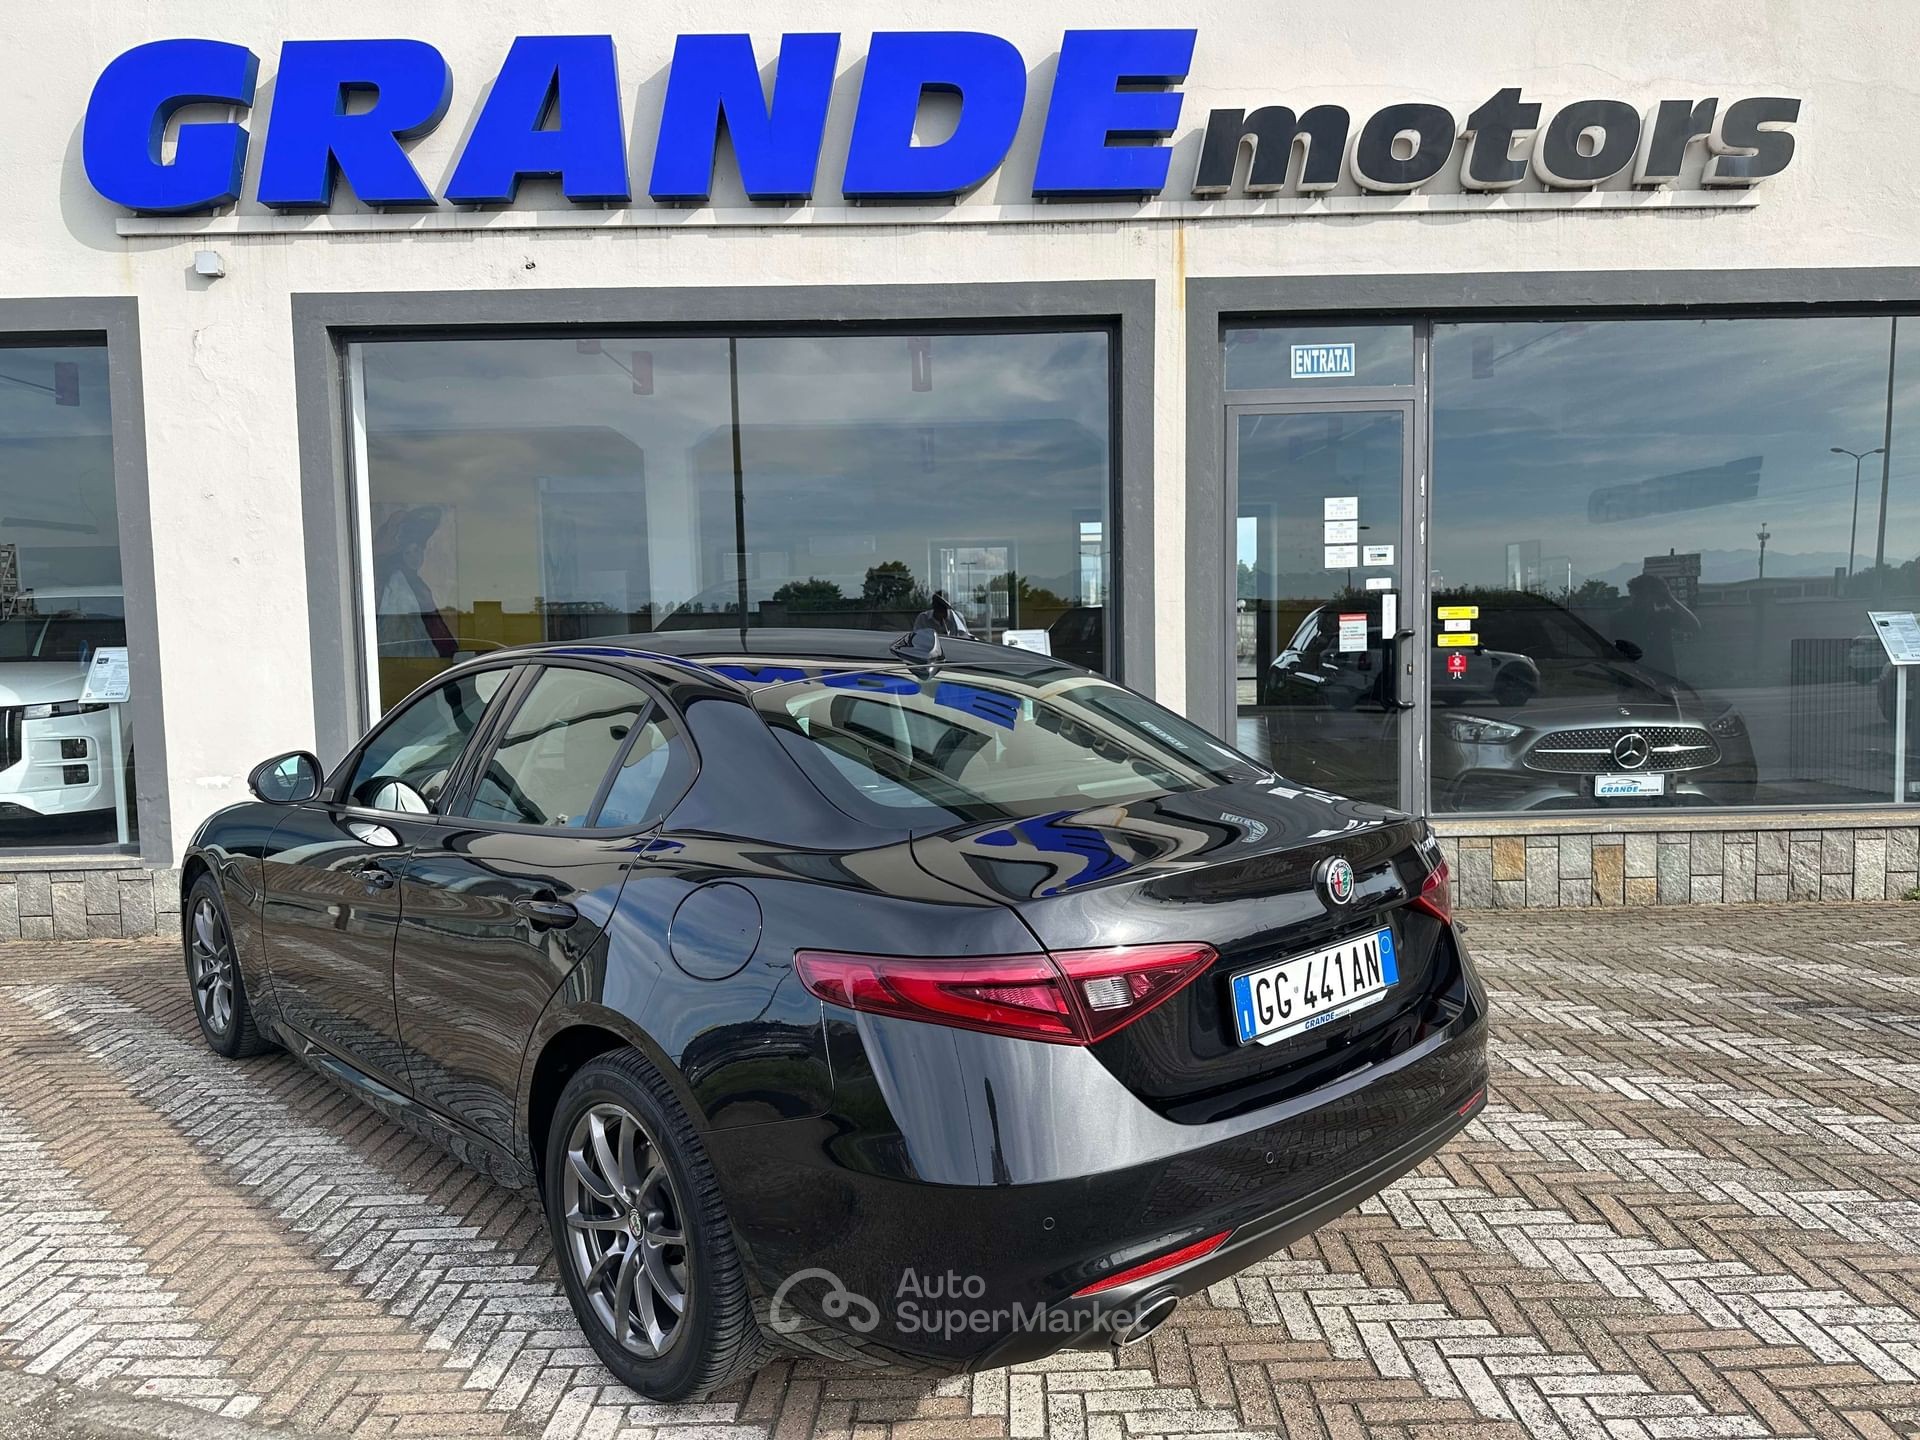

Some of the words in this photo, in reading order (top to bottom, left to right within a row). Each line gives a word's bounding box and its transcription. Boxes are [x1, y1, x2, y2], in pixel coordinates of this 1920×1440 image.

[82, 29, 1198, 213] GRANDE
[1191, 88, 1801, 195] motors
[1295, 348, 1350, 373] ENTRATA
[1256, 972, 1292, 1025] GG
[1305, 1011, 1335, 1029] GRANDE
